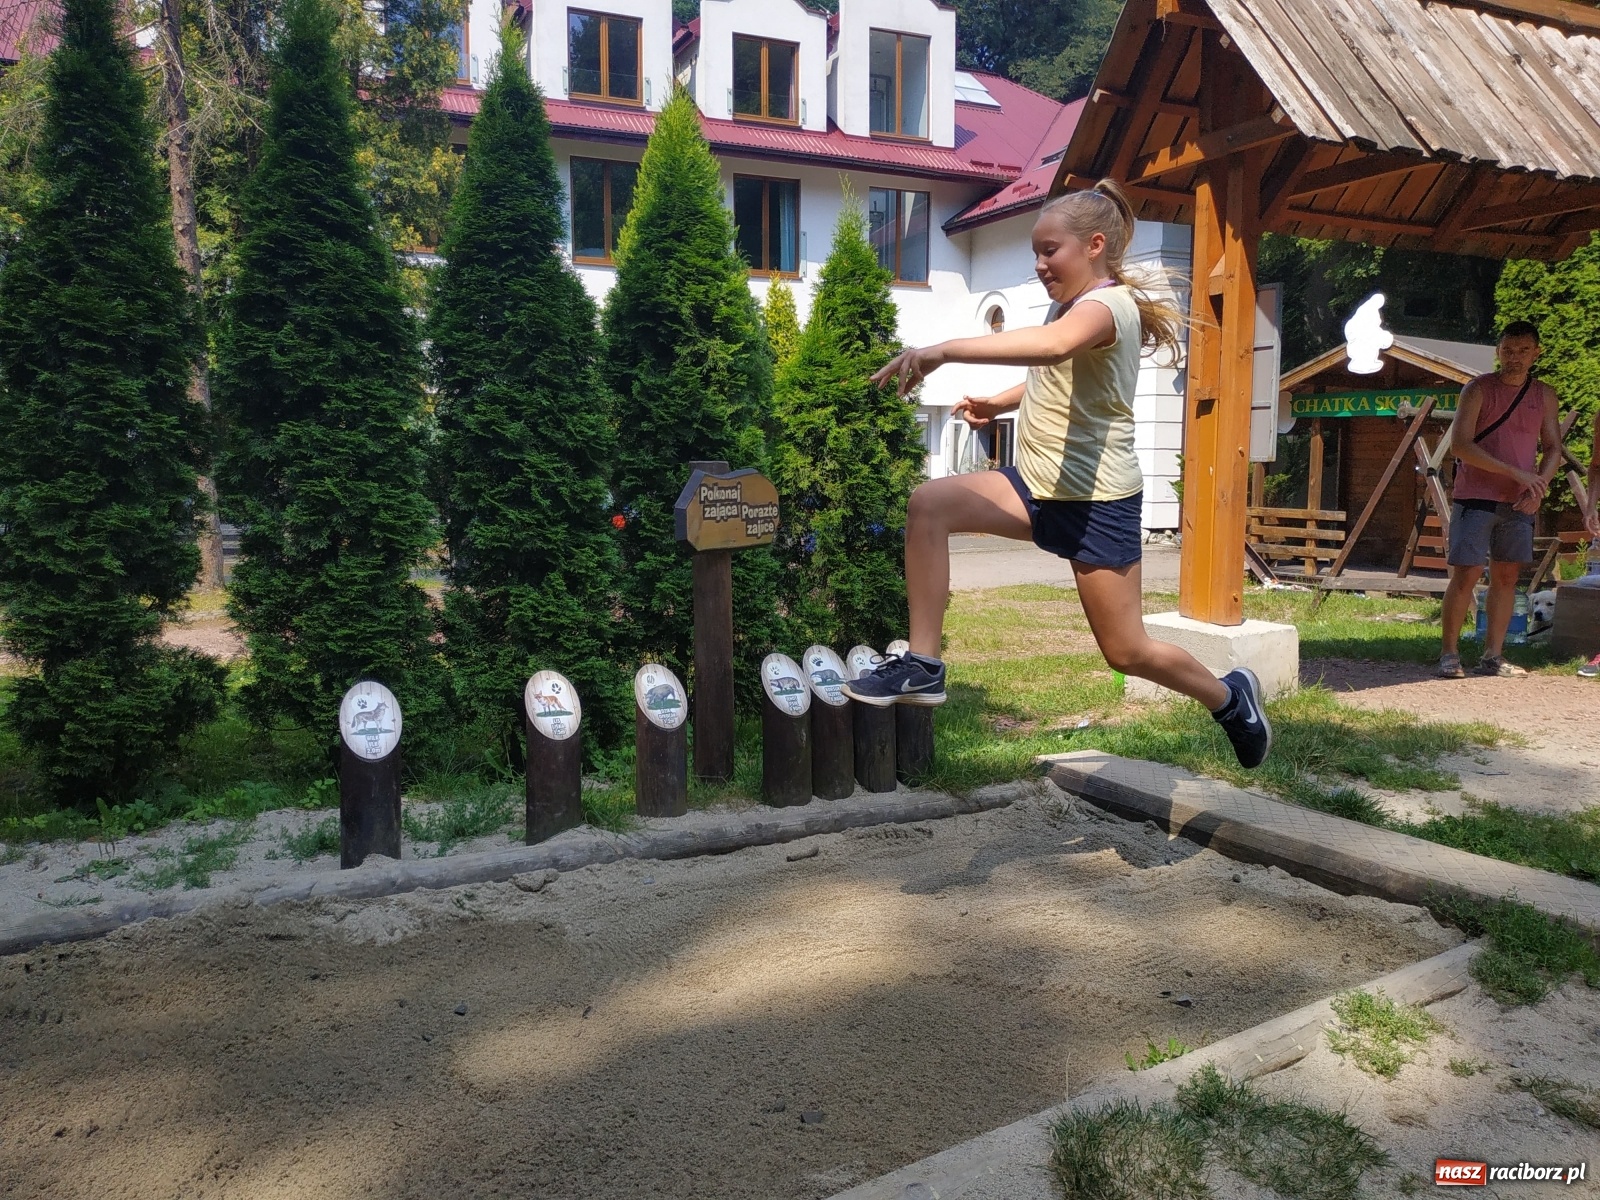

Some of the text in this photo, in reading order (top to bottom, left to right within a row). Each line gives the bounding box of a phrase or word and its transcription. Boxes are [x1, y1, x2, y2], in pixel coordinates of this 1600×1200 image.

[1293, 397, 1370, 413] CHATKA
[700, 484, 741, 502] Pokonaj
[704, 503, 738, 520] zająca
[741, 504, 778, 518] Porazte
